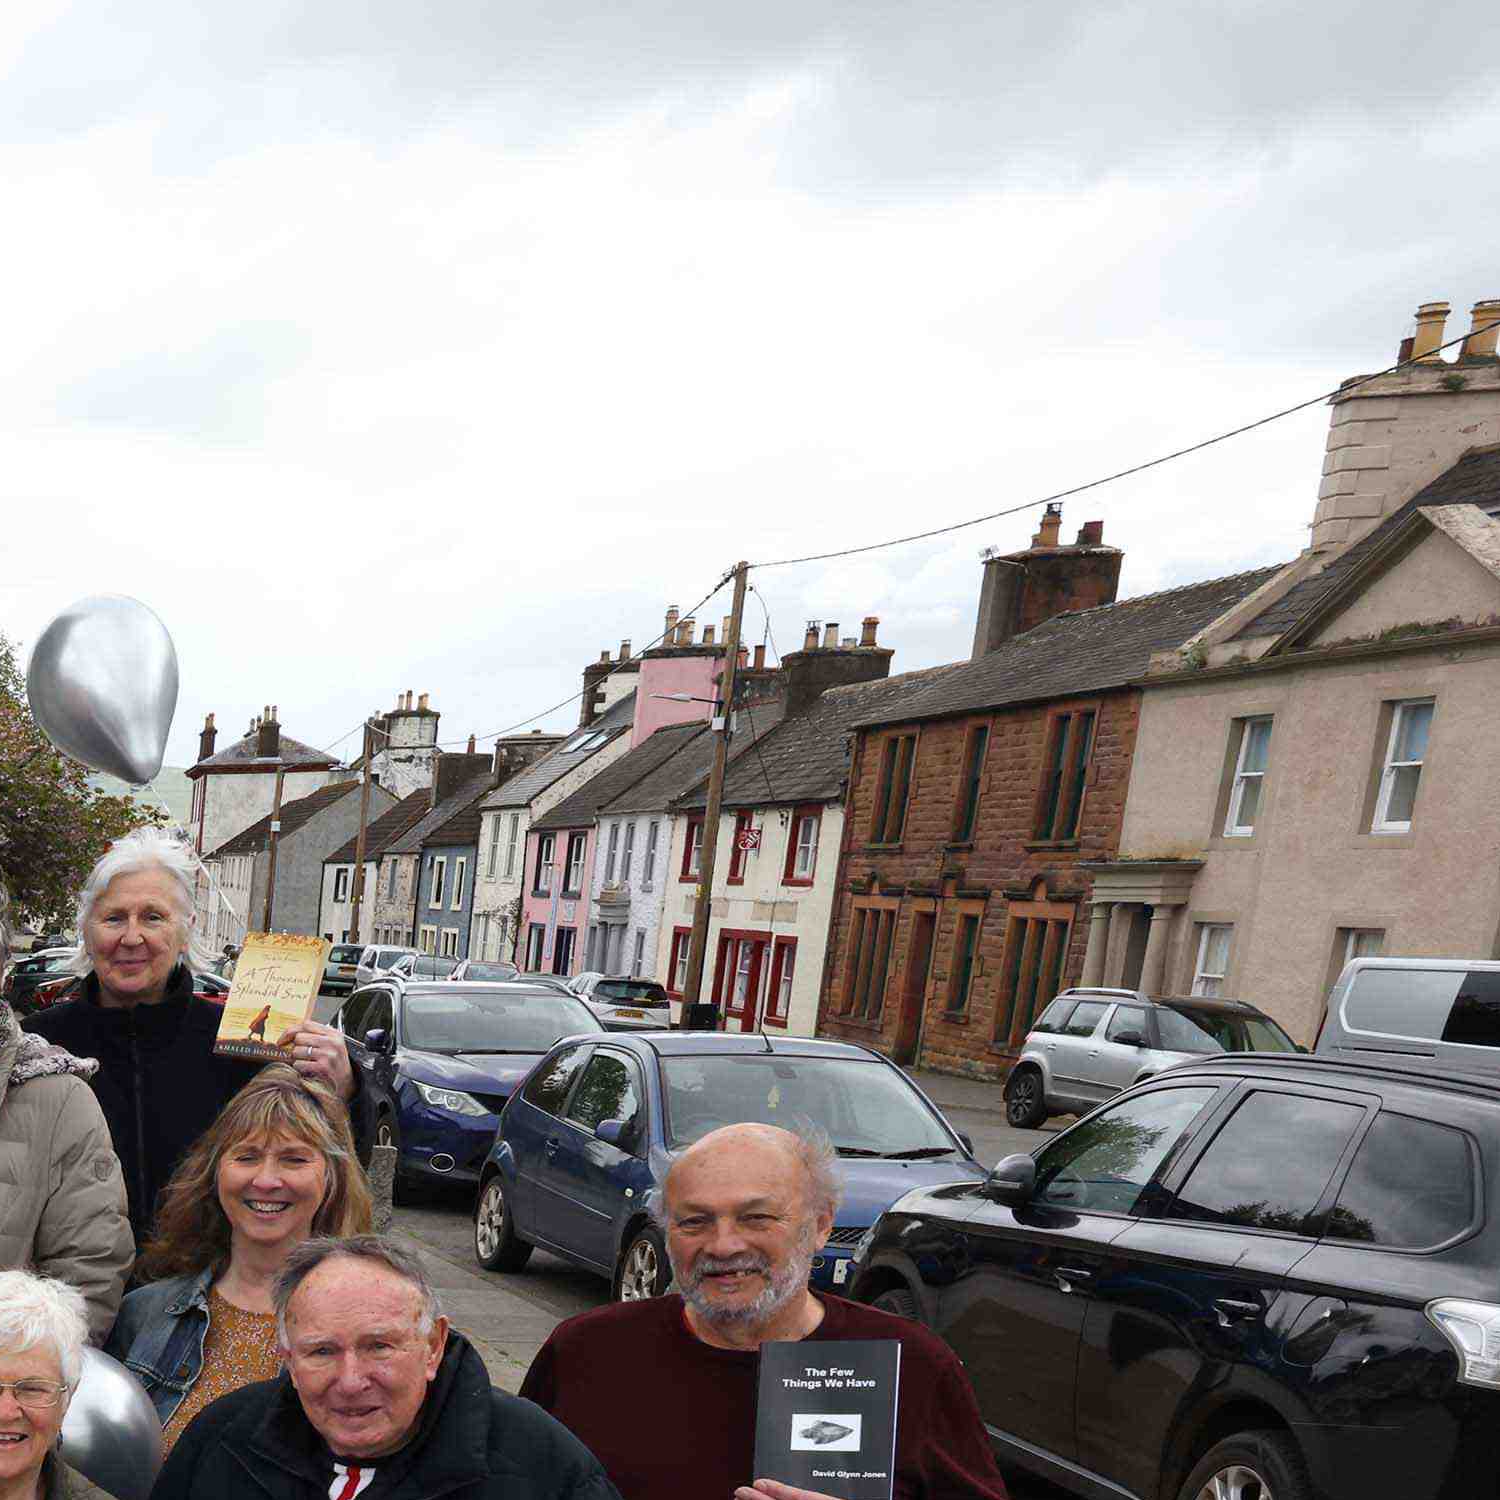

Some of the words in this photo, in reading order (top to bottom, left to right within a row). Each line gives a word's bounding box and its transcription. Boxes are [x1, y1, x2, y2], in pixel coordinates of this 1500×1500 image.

[805, 1368, 826, 1377] The
[830, 1368, 854, 1377] Few
[782, 1379, 821, 1390] Things
[824, 1379, 844, 1388] We
[846, 1379, 876, 1388] Have
[812, 1470, 835, 1478] David
[837, 1471, 861, 1479] Glynn
[862, 1471, 887, 1479] Jones
